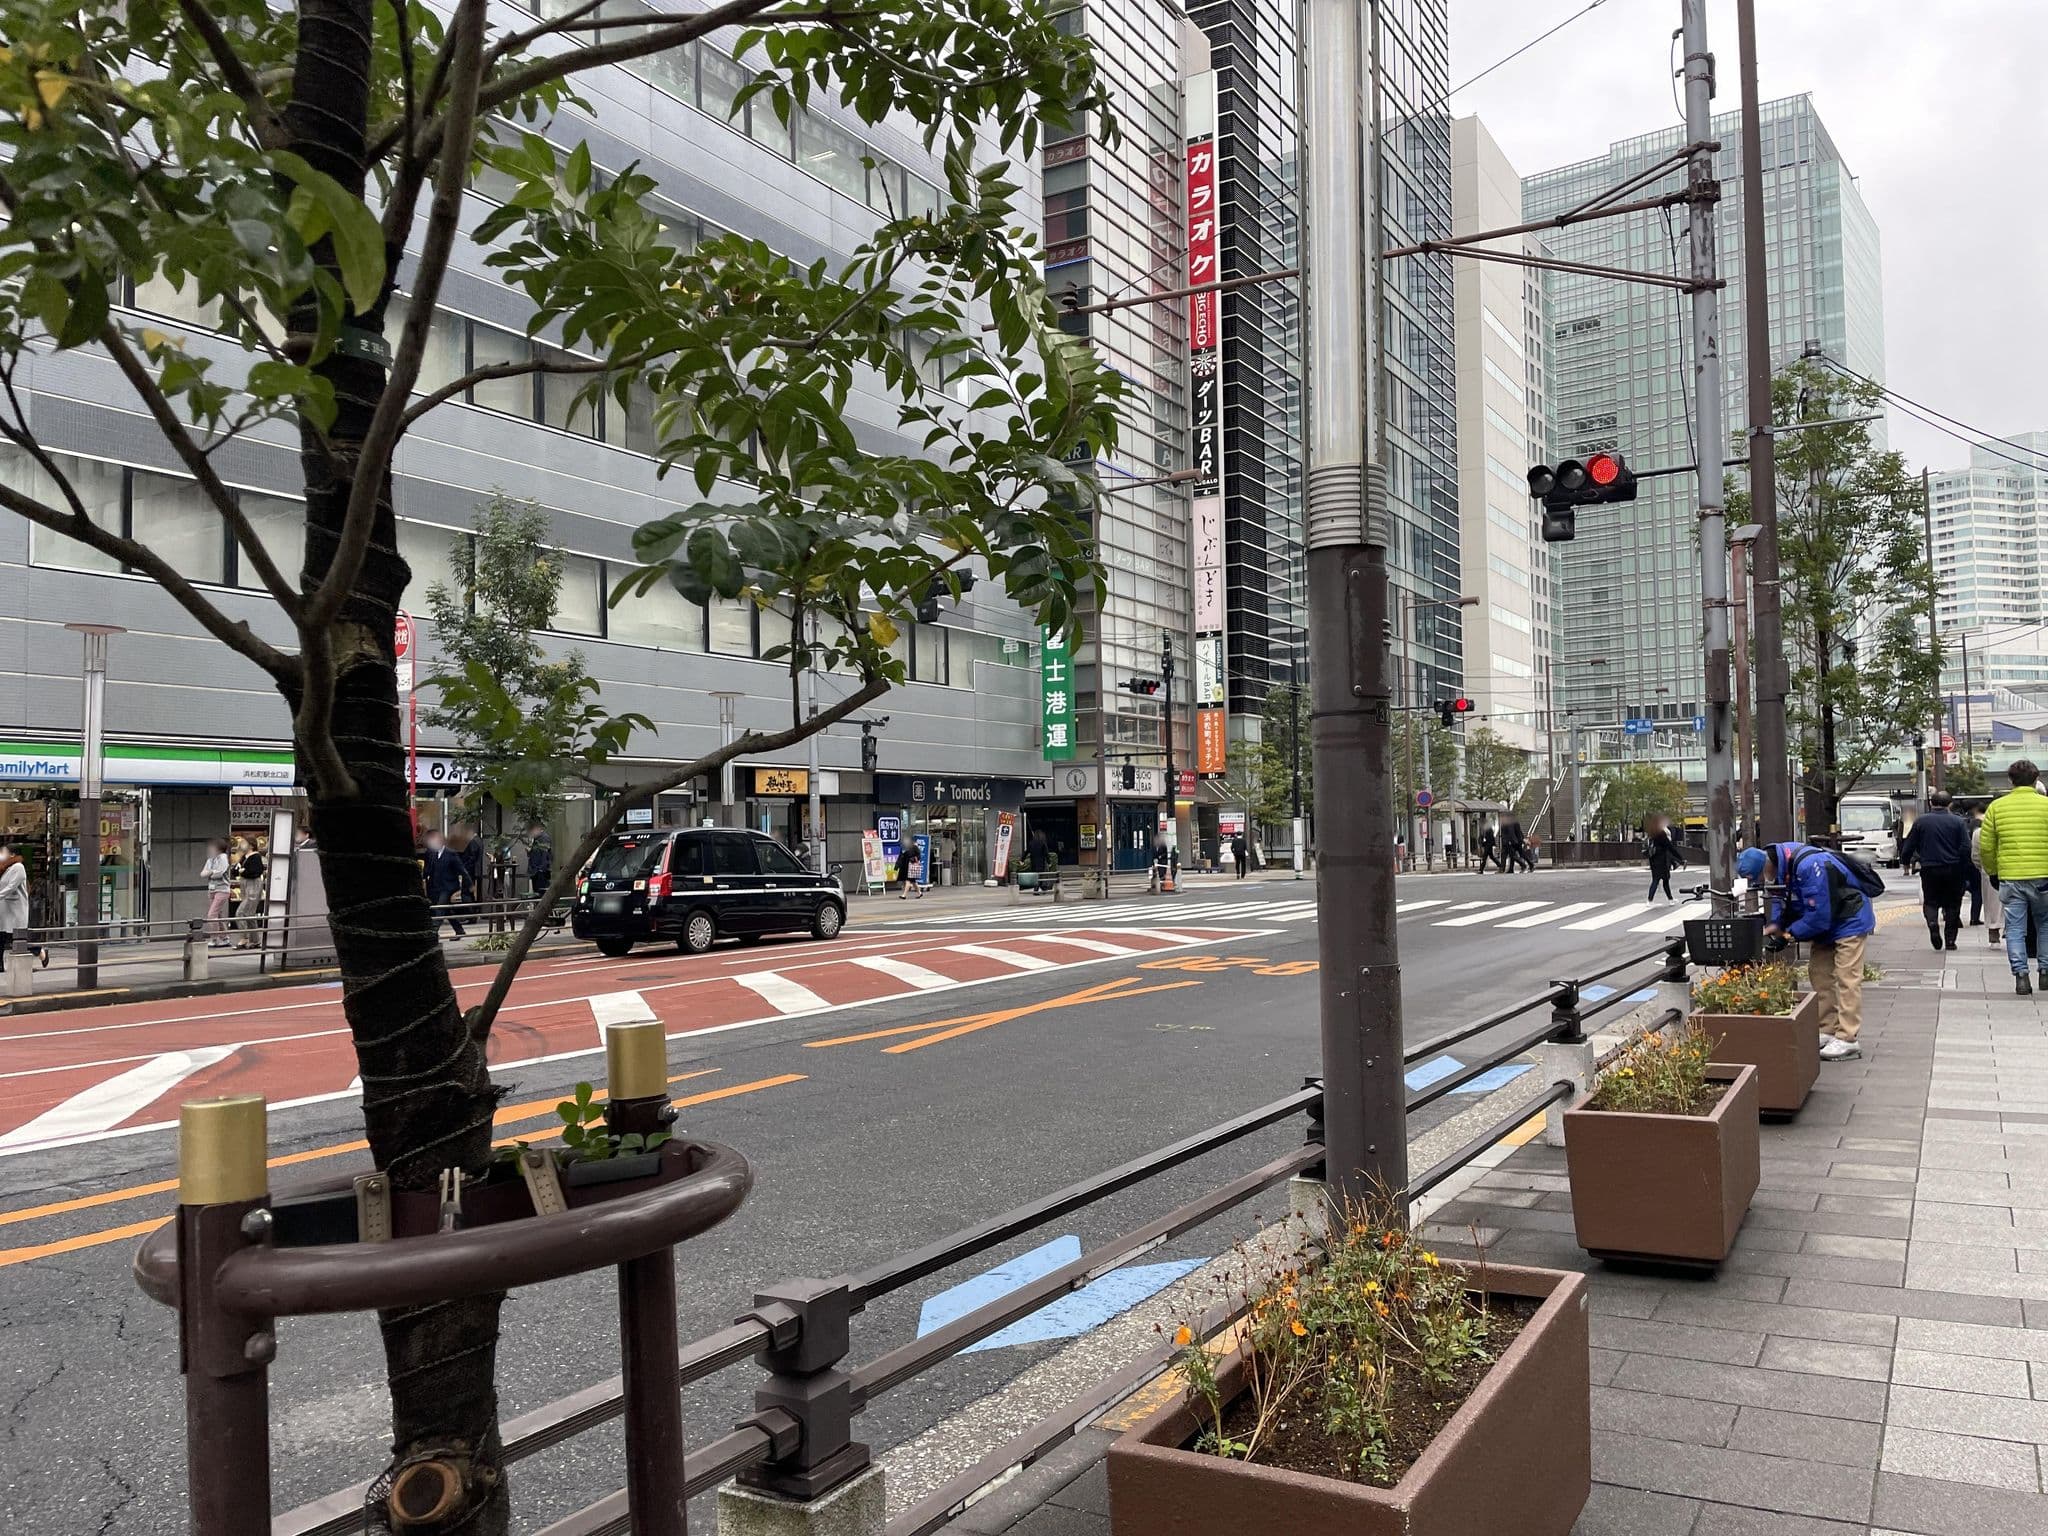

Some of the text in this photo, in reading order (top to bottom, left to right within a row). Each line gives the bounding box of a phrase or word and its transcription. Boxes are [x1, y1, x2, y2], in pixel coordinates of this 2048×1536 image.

[1190, 152, 1213, 277] カラオケ
[950, 783, 991, 801] Tomod's
